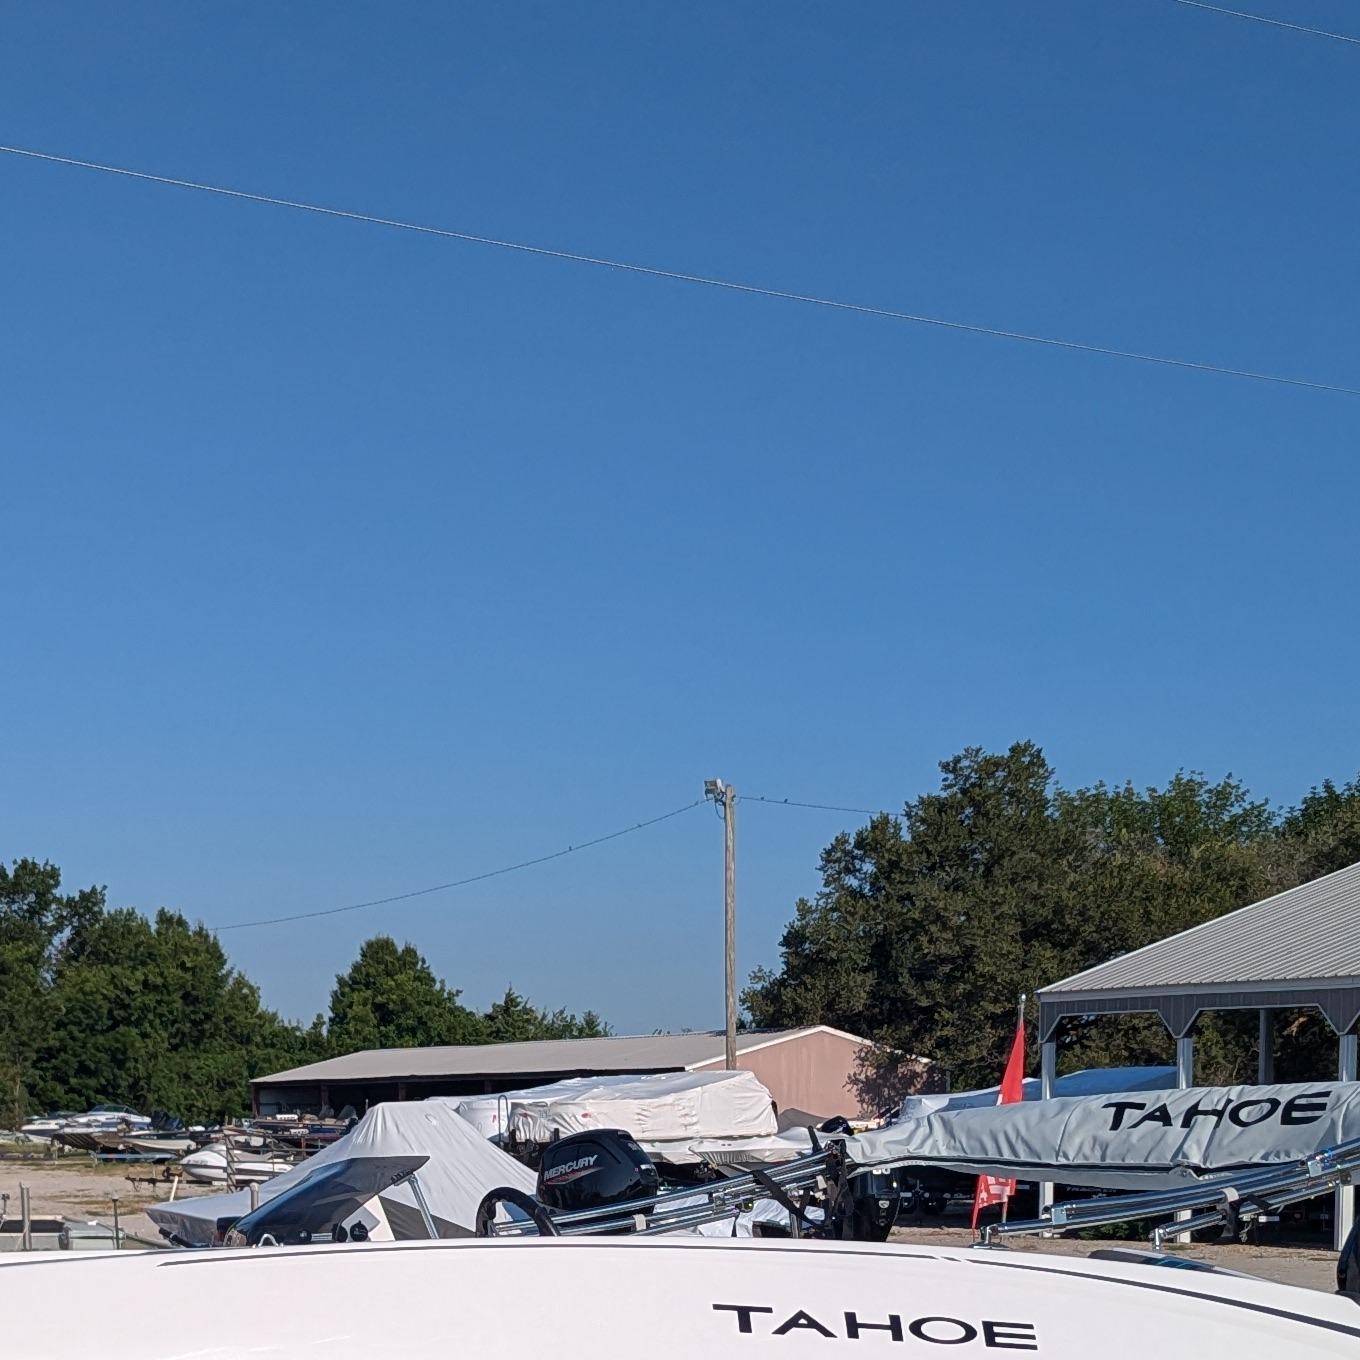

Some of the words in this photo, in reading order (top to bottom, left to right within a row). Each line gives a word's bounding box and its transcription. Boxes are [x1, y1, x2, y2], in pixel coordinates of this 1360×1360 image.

[1101, 1090, 1333, 1132] TAHOE
[544, 1154, 599, 1180] MERCURY
[712, 1303, 1038, 1350] TAHOE
